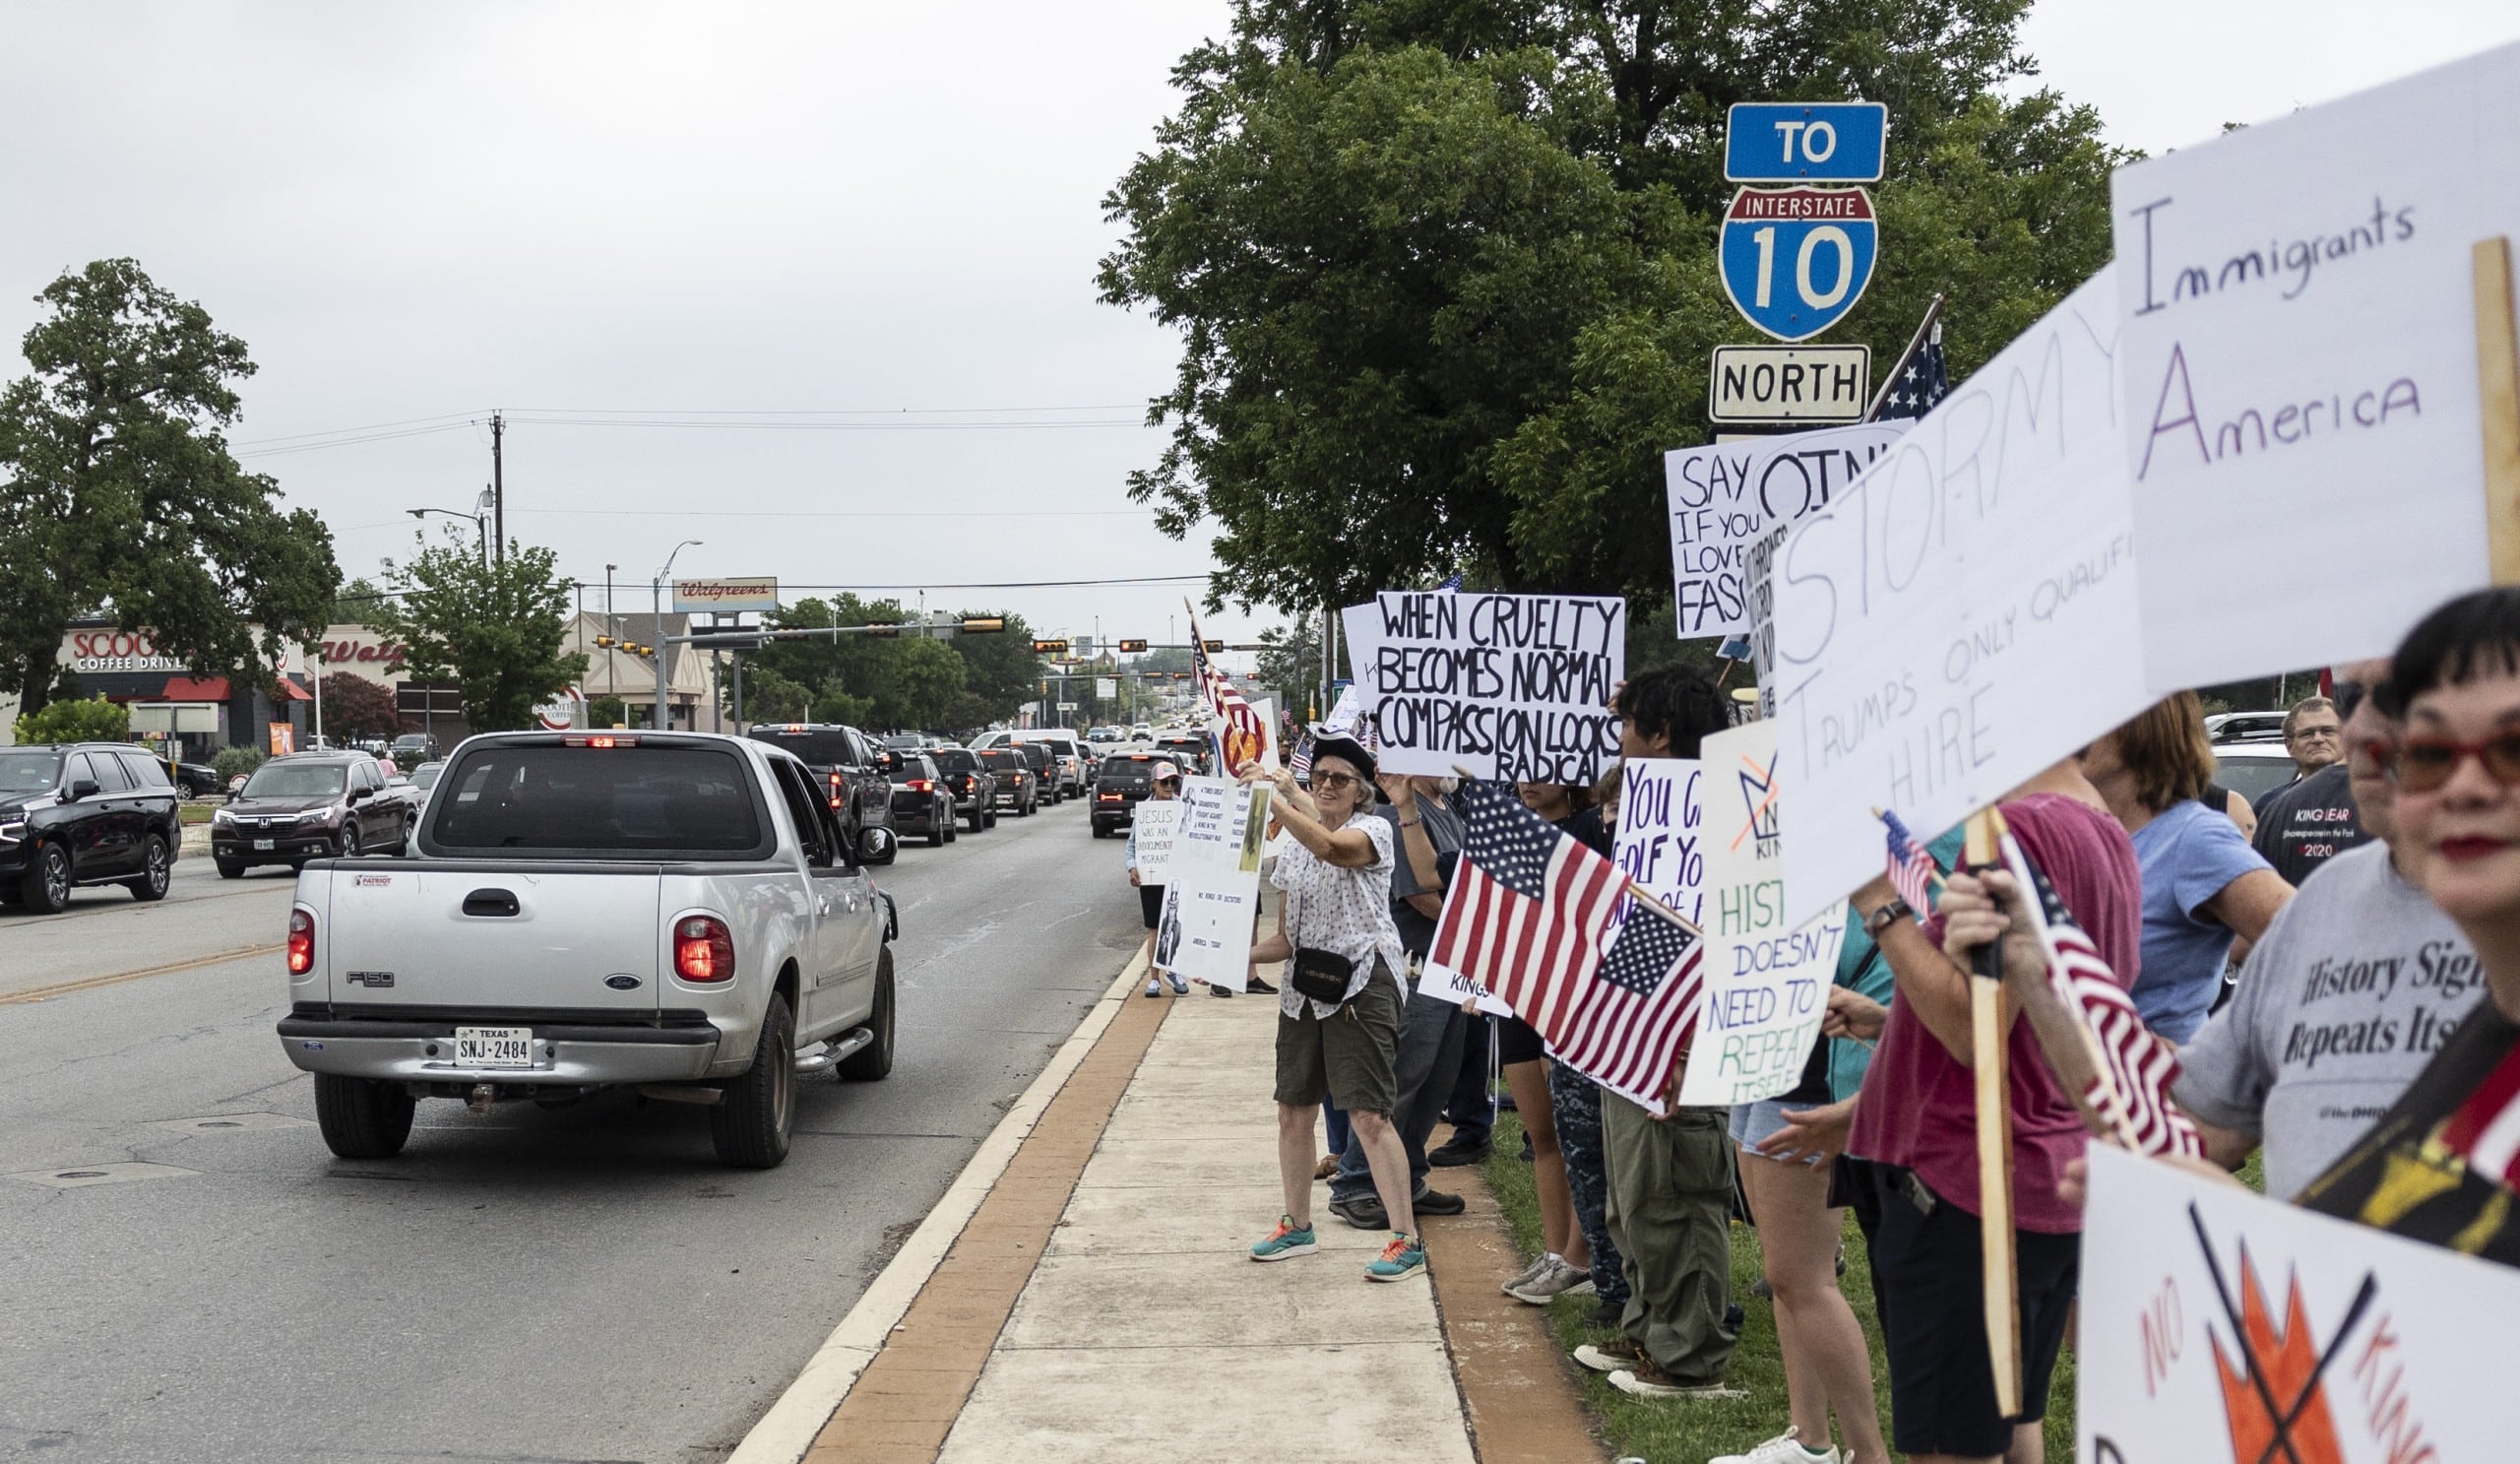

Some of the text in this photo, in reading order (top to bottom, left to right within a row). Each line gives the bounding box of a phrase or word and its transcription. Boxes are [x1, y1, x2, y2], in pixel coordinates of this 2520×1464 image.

[1775, 121, 1837, 163] TO
[1745, 197, 1856, 218] INTERSTATE
[1753, 225, 1854, 310] 10
[2129, 196, 2417, 316] Immigrants
[1723, 363, 1857, 403] NORTH
[1680, 444, 1887, 520] SAY OIN
[1780, 307, 2123, 665] STORMY
[1674, 509, 1760, 544] IF YOU
[1683, 544, 1744, 573] LOVE
[681, 581, 769, 601] Walgreens
[1945, 604, 2016, 682] ONLY
[2031, 534, 2133, 622] QUALIFI
[74, 632, 156, 658] SCOO
[1378, 594, 1620, 658] WHEN CRUELTY
[78, 658, 132, 669] COFFEE
[1378, 647, 1504, 698] BECOMES
[1378, 696, 1543, 756] COMPASSION
[1545, 712, 1622, 757] LOOKS
[1889, 682, 1997, 810] HIRE
[1139, 809, 1173, 824] JESUS
[1625, 763, 1671, 833] YOU
[2295, 808, 2351, 822] KING LEAR
[1158, 828, 1168, 837] AN
[1676, 836, 1703, 887] YO
[1732, 925, 1844, 977] DOESN'T
[1708, 979, 1818, 1032] NEED TO
[2301, 956, 2407, 1006] History
[1719, 1019, 1816, 1077] REPEAT
[2284, 1005, 2459, 1068] Repeats Its
[1731, 1070, 1796, 1103] ITSELF
[2139, 1276, 2183, 1400] NO
